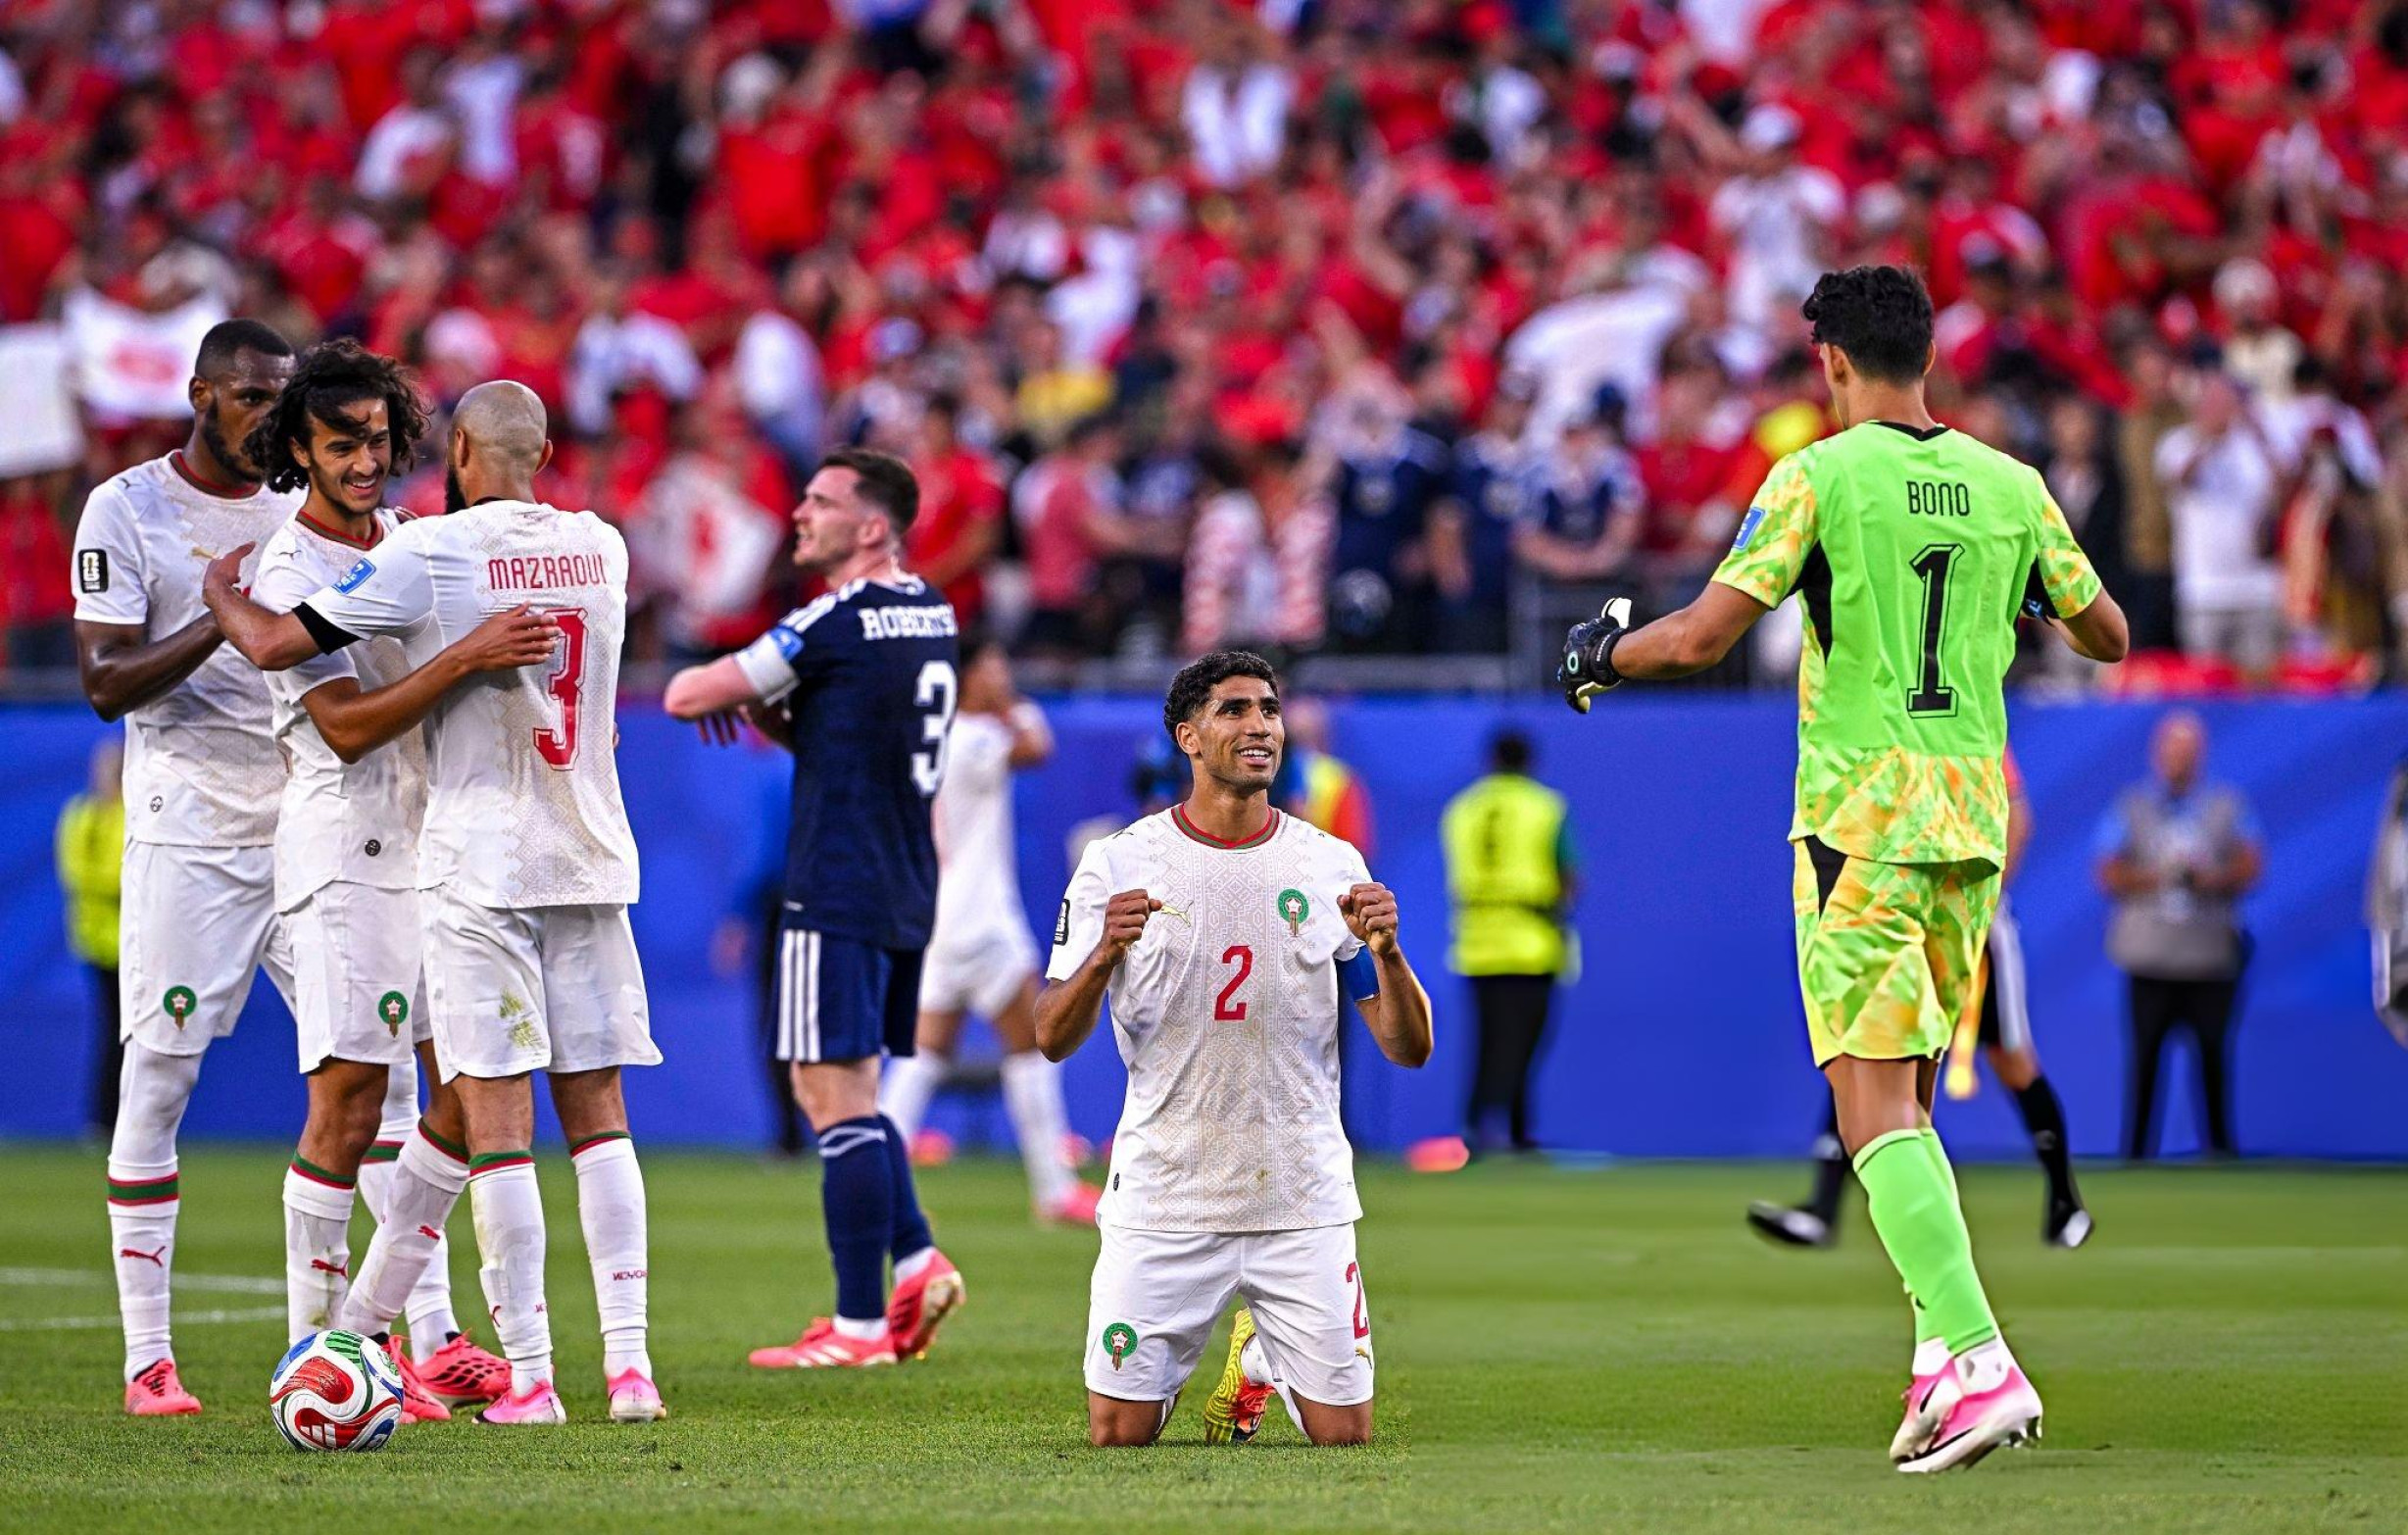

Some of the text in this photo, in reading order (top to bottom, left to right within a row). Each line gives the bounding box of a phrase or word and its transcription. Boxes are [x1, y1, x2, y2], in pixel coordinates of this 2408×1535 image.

[1906, 480, 1970, 517] BONO
[488, 554, 608, 590] MAZRAOUI
[1908, 544, 1965, 718] 1
[533, 608, 589, 771] 3
[911, 660, 958, 797] 3
[1214, 945, 1253, 1020] 2
[1346, 1261, 1369, 1340] 2
